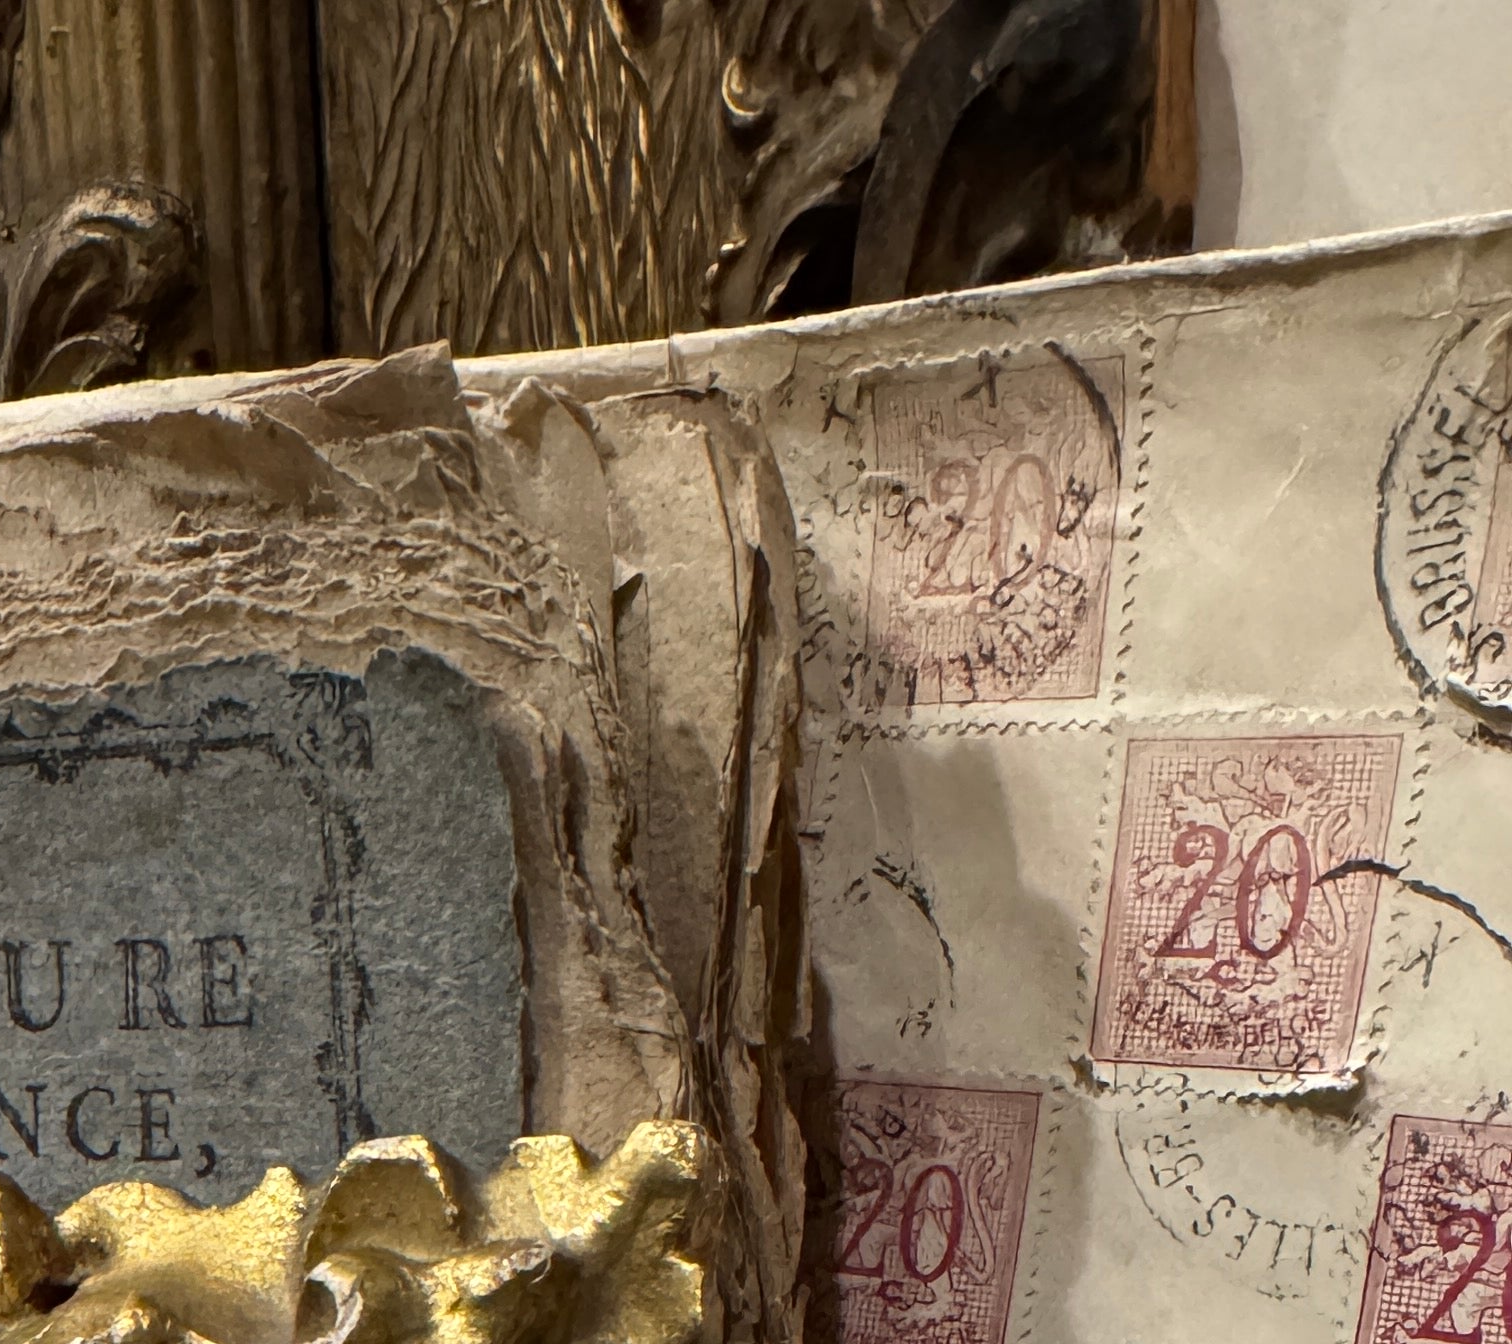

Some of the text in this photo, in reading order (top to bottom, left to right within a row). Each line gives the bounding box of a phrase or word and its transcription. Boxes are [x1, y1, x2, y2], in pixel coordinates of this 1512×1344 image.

[913, 453, 1058, 598] 20
[1153, 824, 1311, 960] 20
[834, 1156, 966, 1284] 20
